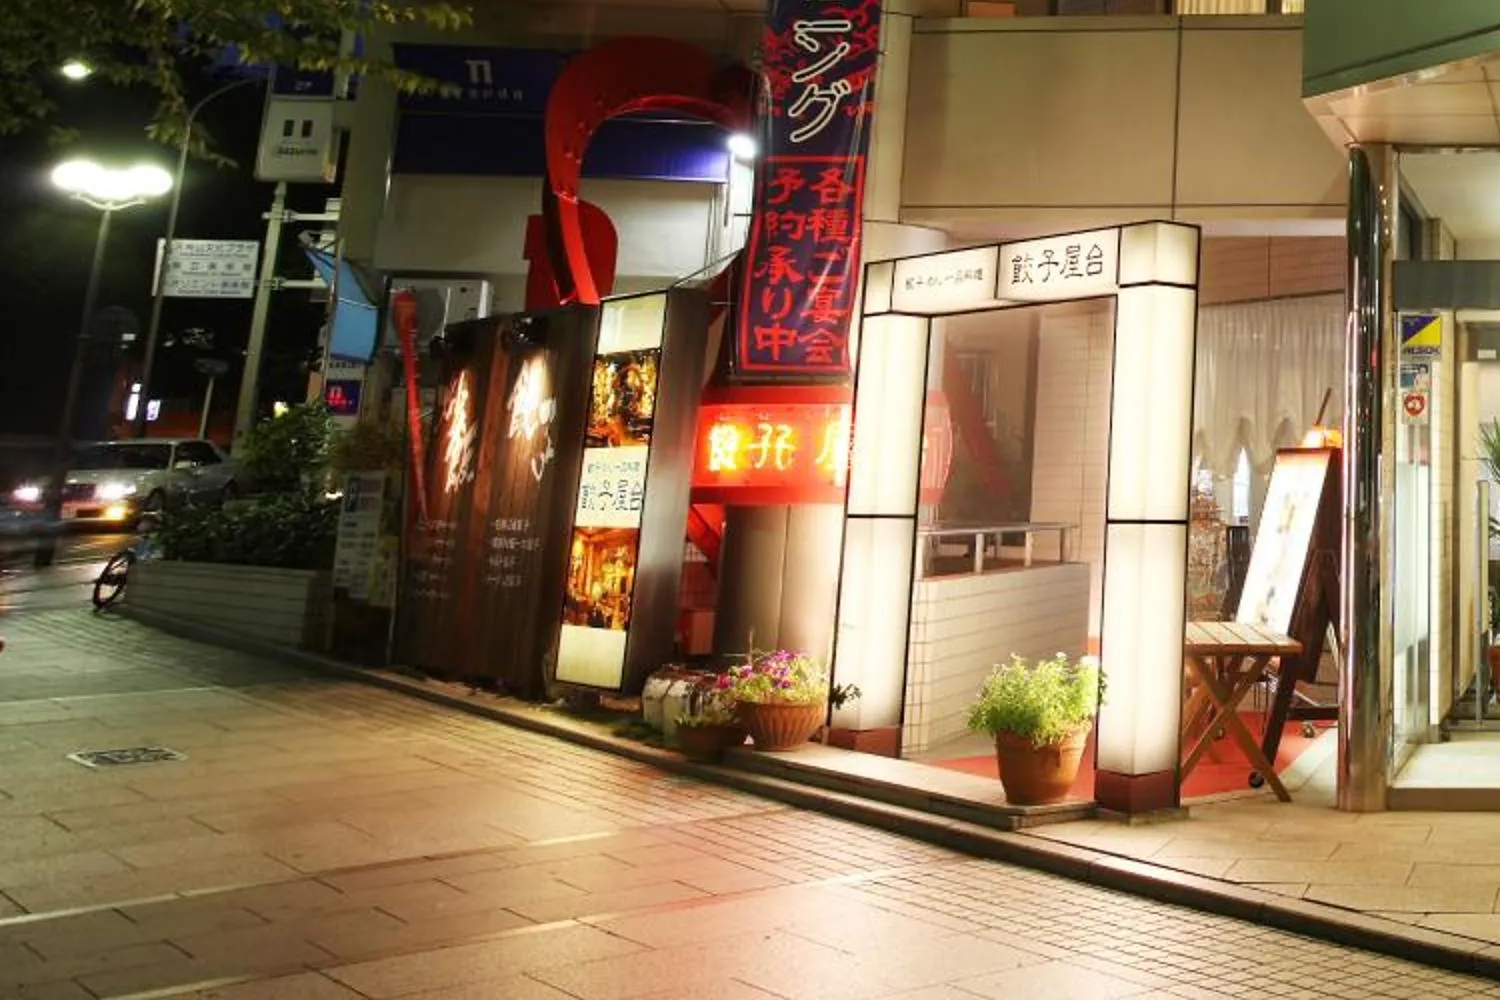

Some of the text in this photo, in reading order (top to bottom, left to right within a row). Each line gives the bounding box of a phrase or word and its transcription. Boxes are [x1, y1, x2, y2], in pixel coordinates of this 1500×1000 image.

[753, 167, 806, 361] 予約承り中
[798, 167, 856, 364] 各種ご宴会
